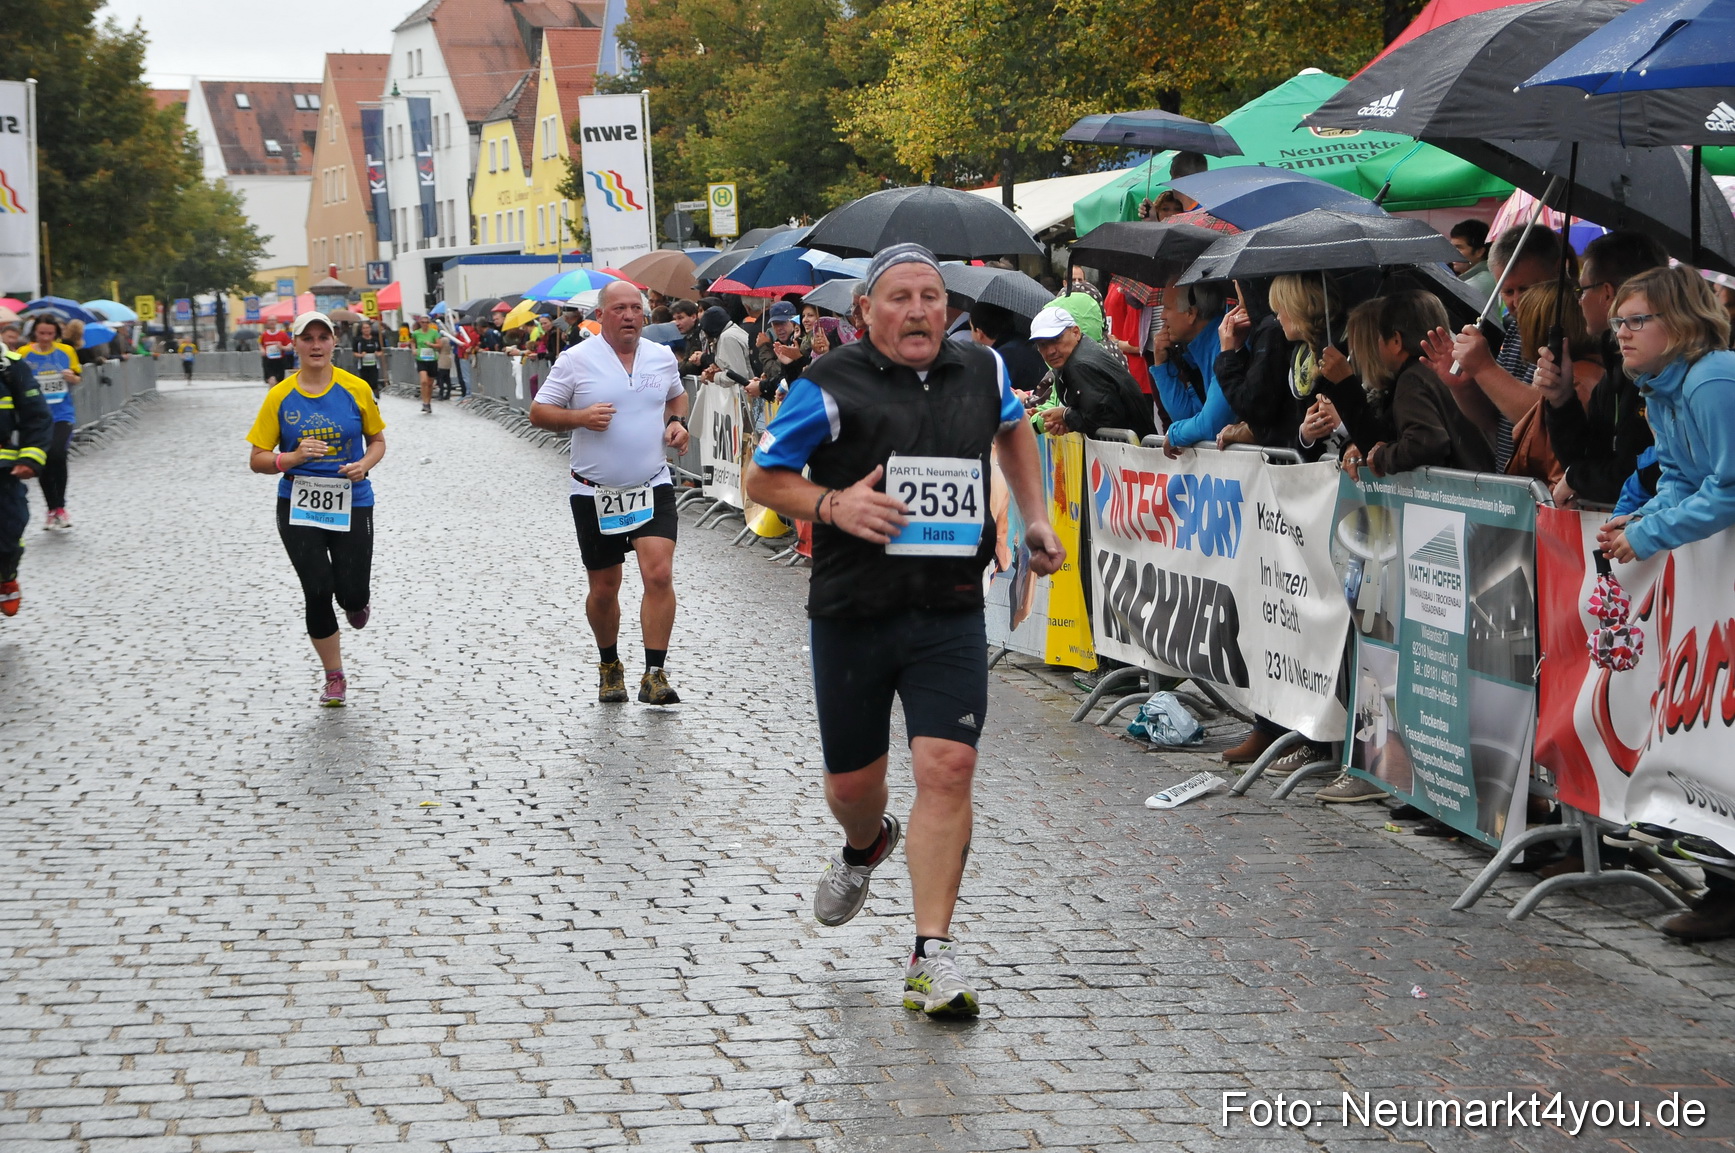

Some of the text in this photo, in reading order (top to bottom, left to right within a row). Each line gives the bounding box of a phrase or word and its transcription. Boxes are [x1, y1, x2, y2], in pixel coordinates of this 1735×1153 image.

[1357, 105, 1397, 118] adidas
[889, 466, 968, 478] PARTL Neumarkt
[297, 489, 345, 510] 2881
[601, 490, 646, 515] 2171
[898, 481, 978, 518] 2534
[1499, 500, 1516, 517] Bayern
[305, 512, 335, 523] Sabrina
[923, 527, 955, 541] Hans
[1260, 556, 1272, 587] Im
[1408, 564, 1461, 591] MATHI HOFFER
[1420, 710, 1449, 733] Trockenbau
